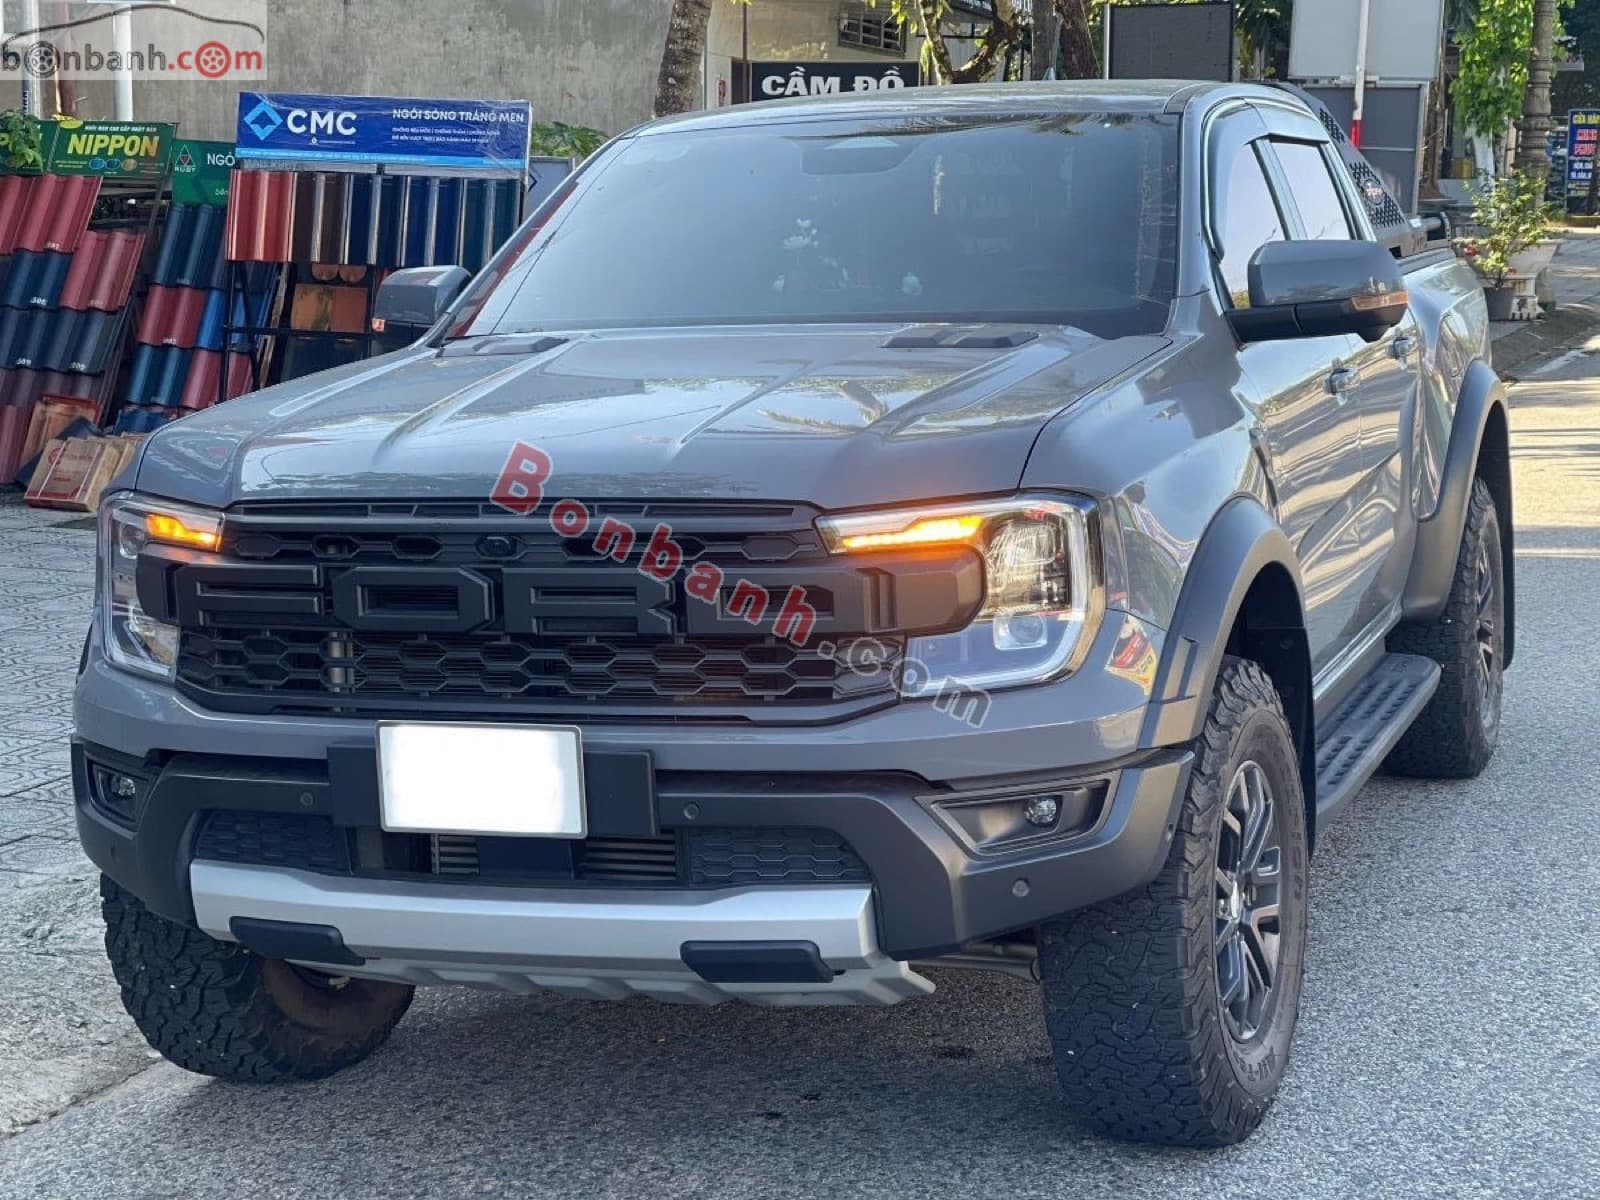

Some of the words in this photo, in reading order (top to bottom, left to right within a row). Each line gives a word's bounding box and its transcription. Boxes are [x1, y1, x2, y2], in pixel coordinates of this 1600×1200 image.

[761, 66, 841, 96] CẦM
[853, 65, 905, 92] ĐỒ
[287, 109, 357, 135] CMC
[499, 112, 524, 122] MEN
[67, 134, 159, 157] NIPPON
